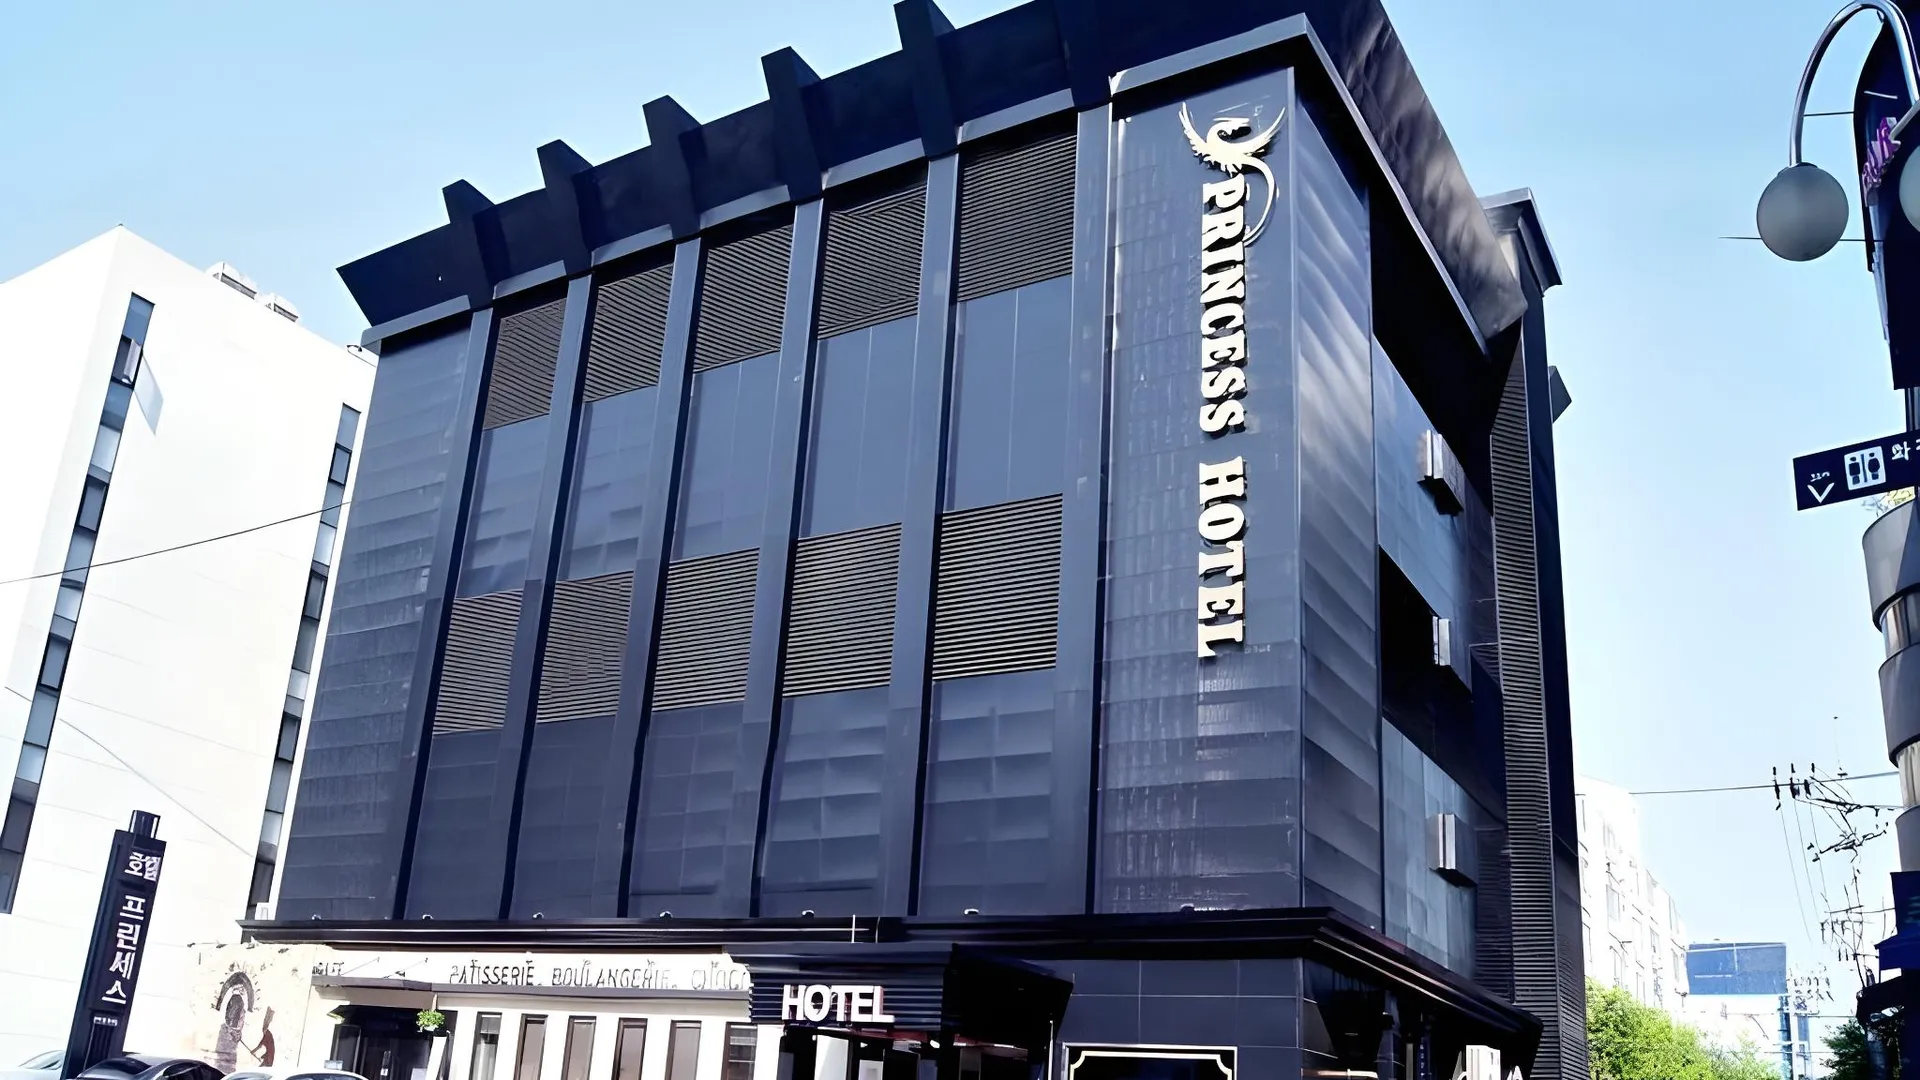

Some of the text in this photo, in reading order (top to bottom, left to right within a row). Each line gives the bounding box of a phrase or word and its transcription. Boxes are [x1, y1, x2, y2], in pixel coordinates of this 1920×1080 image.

[1198, 173, 1246, 657] PRINCESS HOTEL
[101, 895, 145, 1005] 프린세스
[781, 984, 895, 1023] HOTEL
